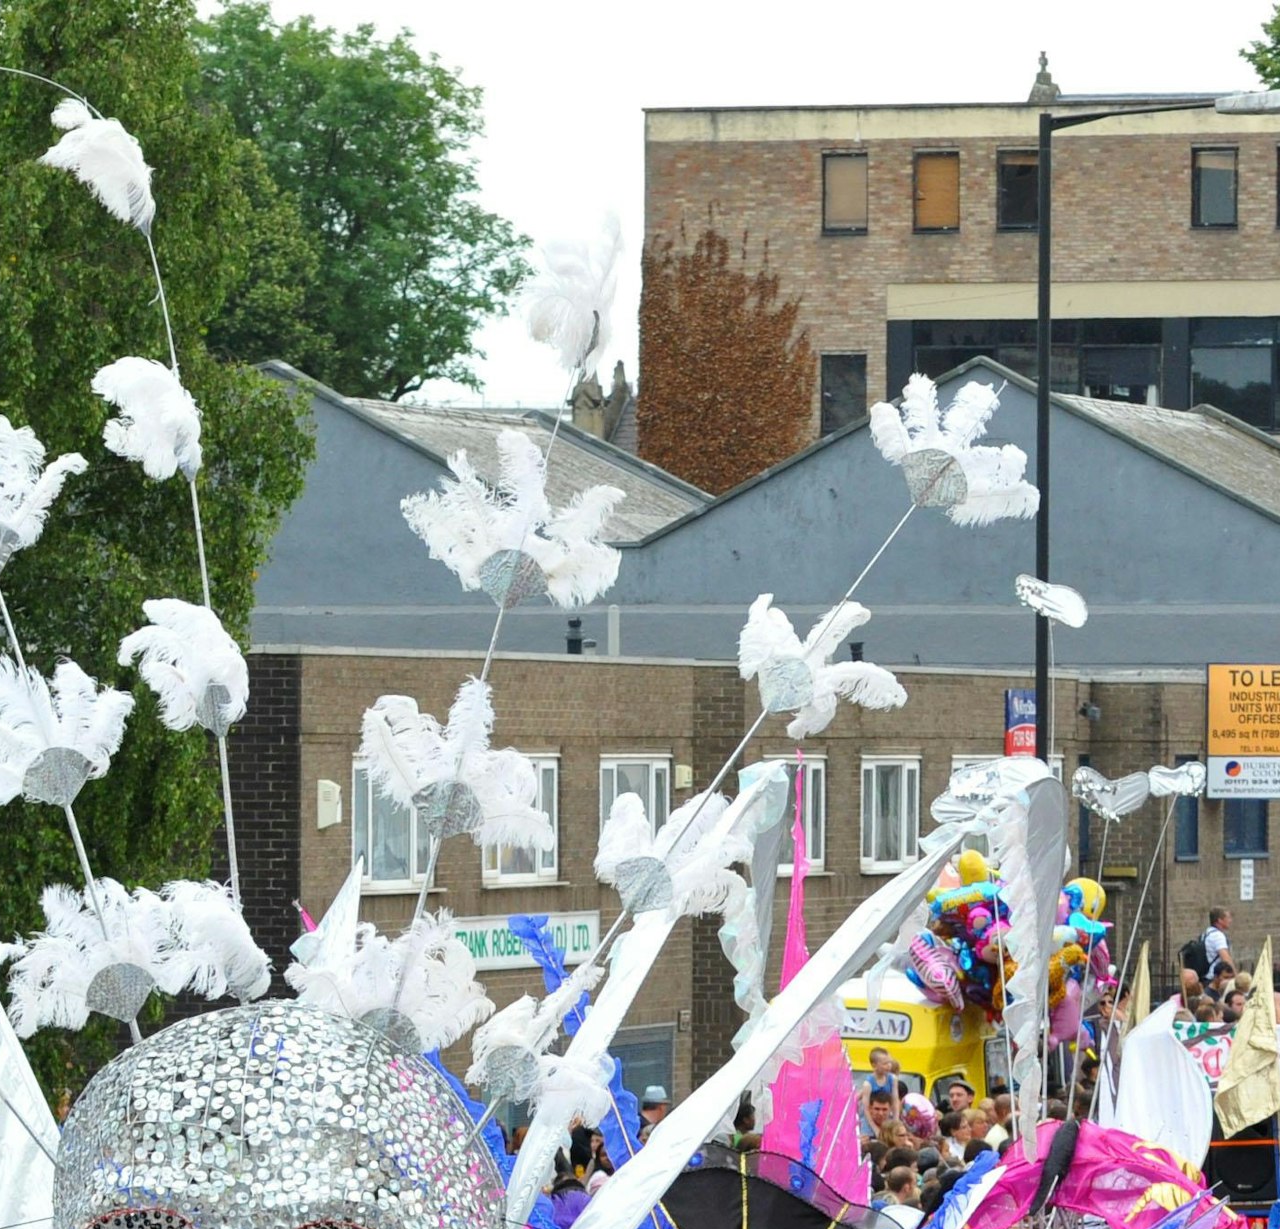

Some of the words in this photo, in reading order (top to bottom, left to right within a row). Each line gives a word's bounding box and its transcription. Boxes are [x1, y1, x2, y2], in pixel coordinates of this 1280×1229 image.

[1229, 670, 1255, 687] TO
[1230, 703, 1262, 713] UNITS
[1212, 729, 1236, 740] 8,495
[1238, 731, 1249, 740] sq
[1252, 730, 1259, 739] ft
